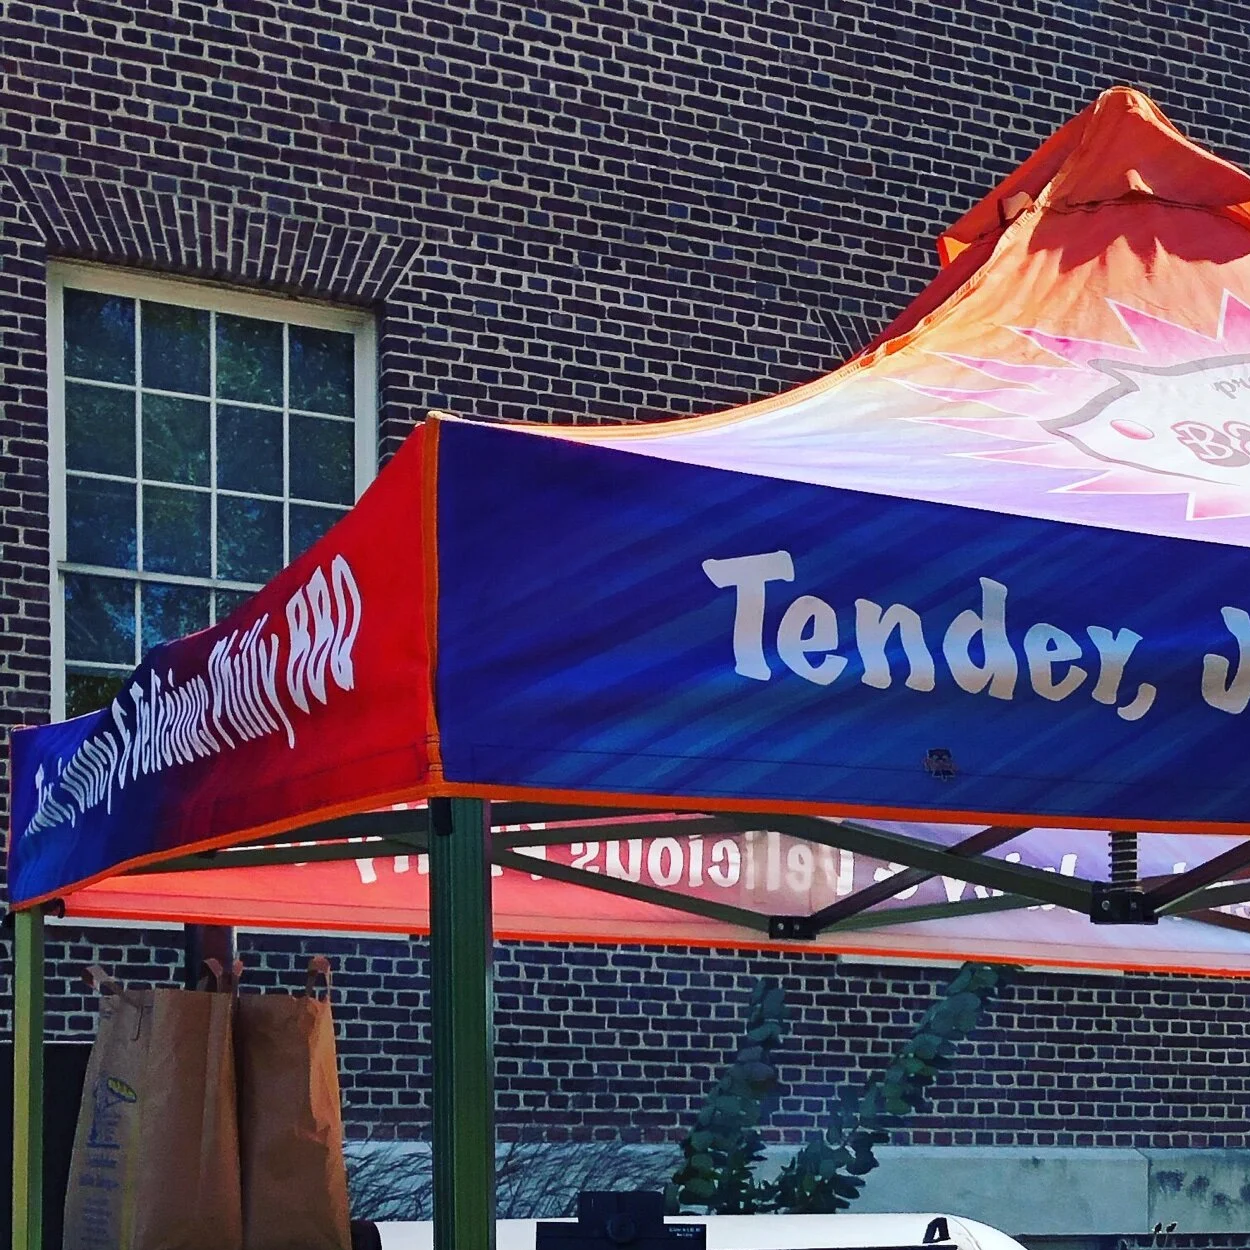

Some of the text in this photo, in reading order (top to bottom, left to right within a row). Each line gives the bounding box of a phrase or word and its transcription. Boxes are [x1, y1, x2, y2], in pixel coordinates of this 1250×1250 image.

[208, 613, 295, 749] Philly
[285, 554, 362, 715] BBQ
[702, 550, 1157, 721] Tender,
